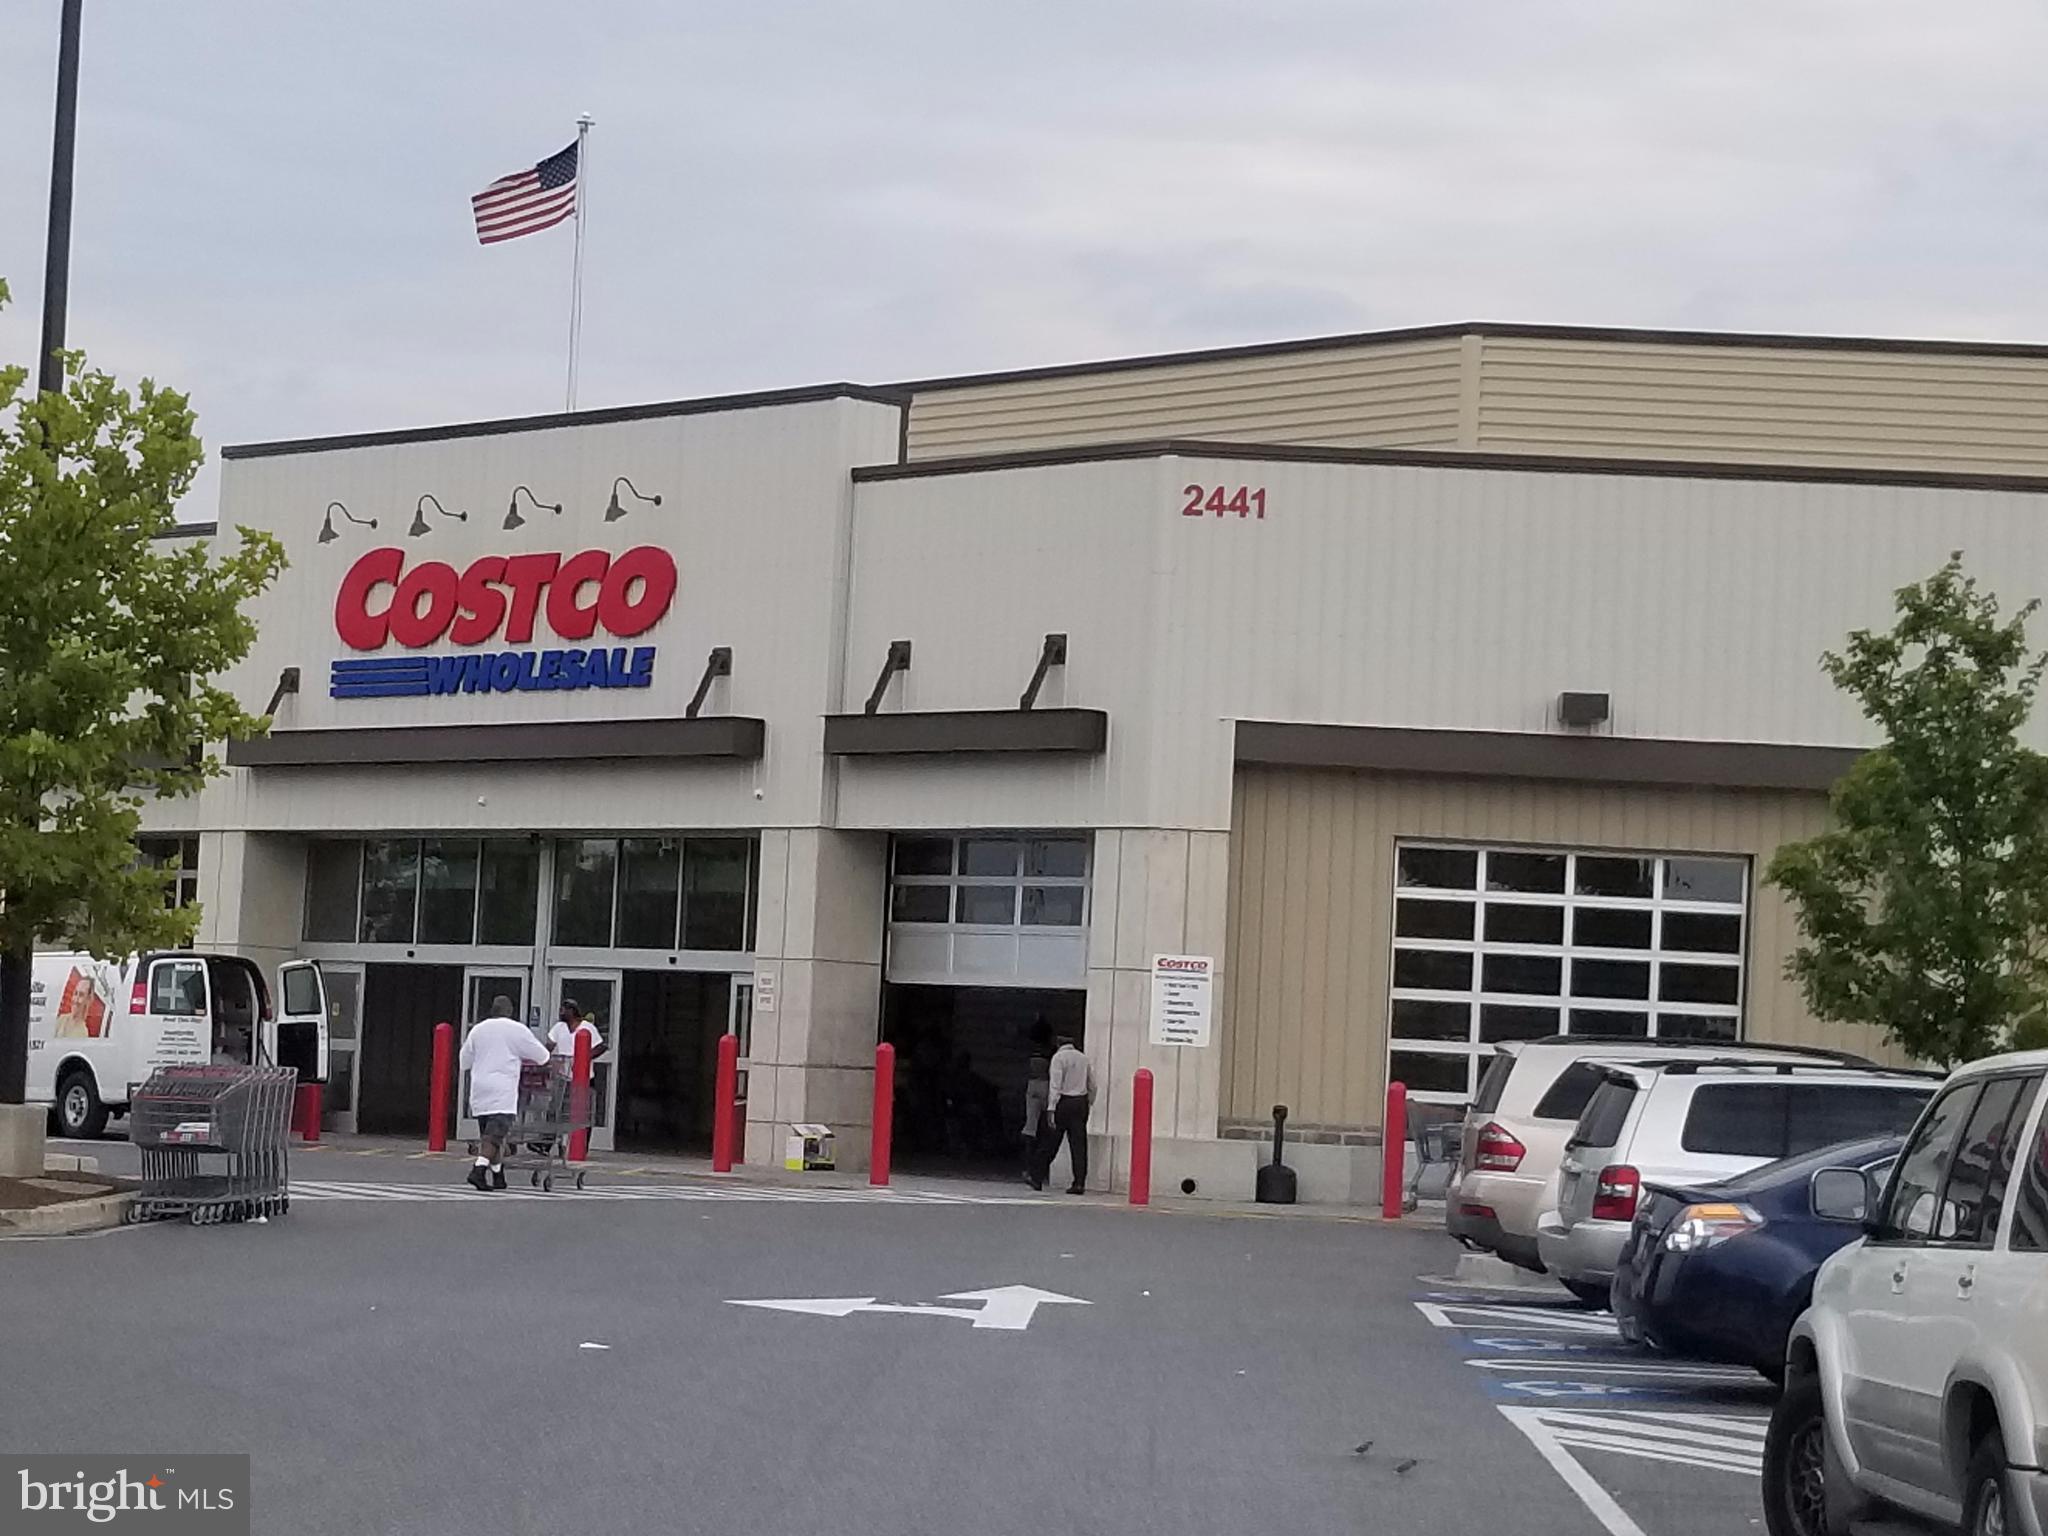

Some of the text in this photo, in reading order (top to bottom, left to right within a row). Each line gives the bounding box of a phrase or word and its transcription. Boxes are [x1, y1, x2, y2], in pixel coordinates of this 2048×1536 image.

[1182, 484, 1266, 519] 2441
[335, 546, 678, 652] COSTCO
[427, 646, 656, 697] WHOLESALE
[1157, 958, 1208, 969] COSTCO
